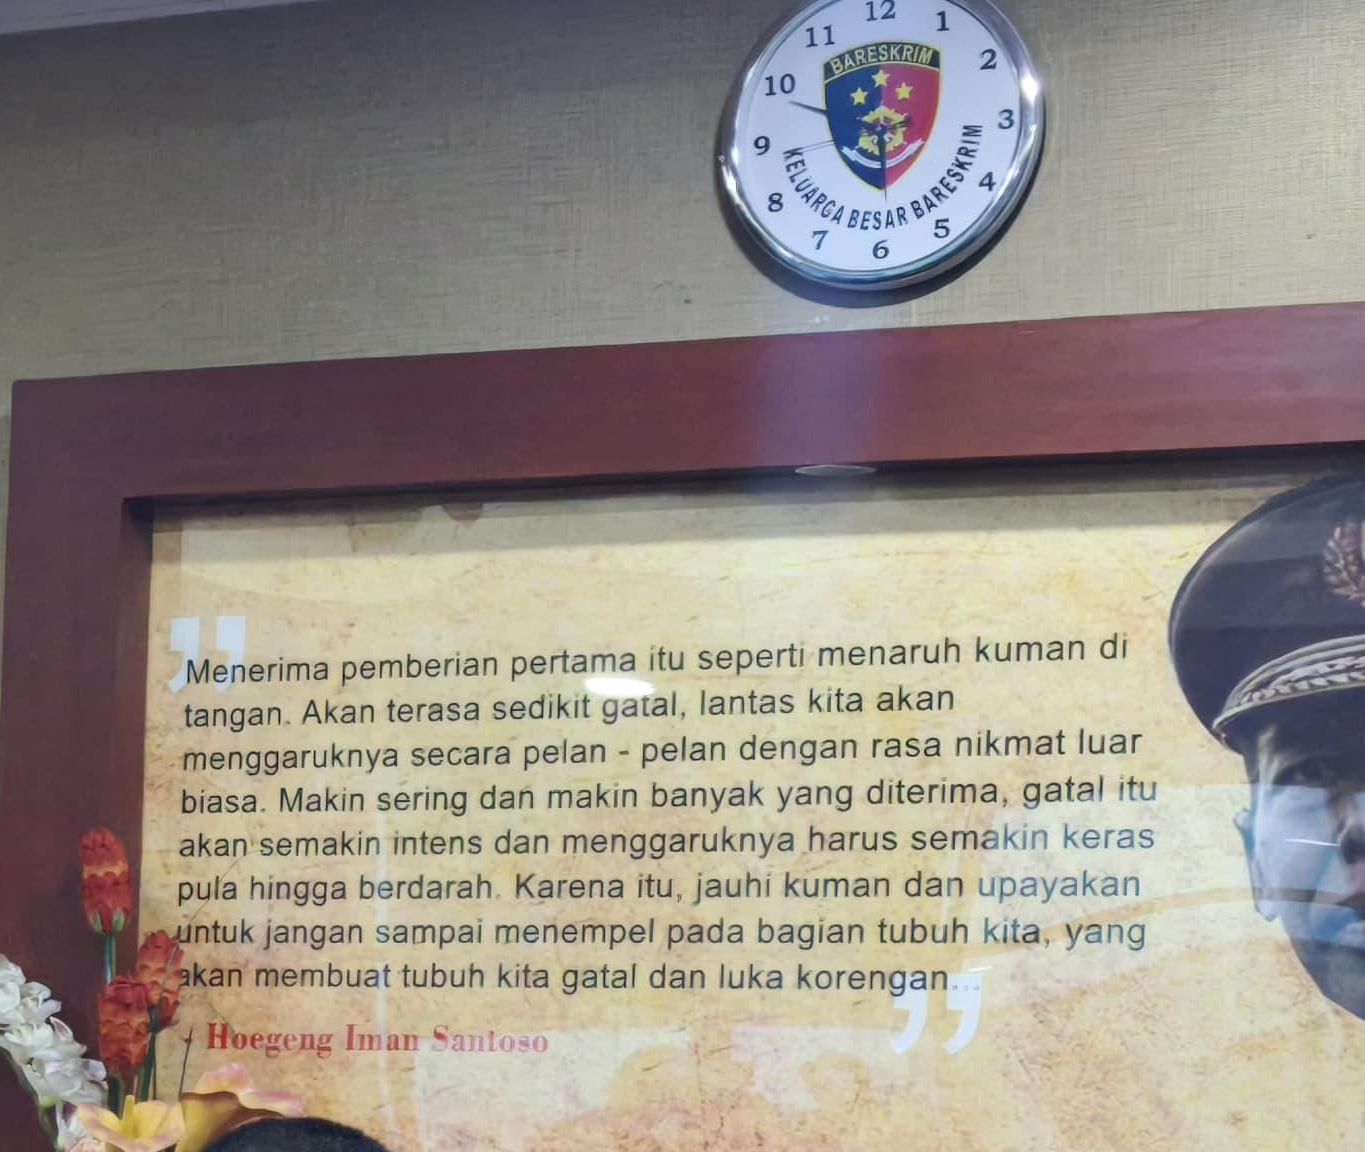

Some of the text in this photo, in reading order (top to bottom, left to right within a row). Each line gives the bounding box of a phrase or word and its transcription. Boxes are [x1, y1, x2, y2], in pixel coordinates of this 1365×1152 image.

[865, 0, 895, 22] 12
[937, 11, 949, 31] 1
[805, 25, 836, 47] 11
[830, 44, 933, 75] BARESKRIM
[980, 49, 997, 70] 2
[765, 74, 795, 96] 10
[997, 110, 1015, 129] 3
[754, 136, 770, 155] 9
[783, 125, 982, 231] KELUARGA BESAR BARESKRIM
[979, 172, 996, 191] 4
[768, 193, 783, 212] 8
[934, 218, 950, 238] 5
[812, 231, 828, 250] 7
[872, 240, 890, 259] 6
[186, 633, 1128, 685] Menerima pemberian pertama itu seperti menaruh kuman di
[185, 686, 954, 732] tangan. Akan terasa sedikit gatal, lantas kita akan
[183, 744, 398, 776] menggaruknya
[411, 746, 510, 767] secara
[524, 741, 606, 770] pelan
[642, 736, 725, 767] pelan
[740, 735, 857, 766] dengan
[871, 737, 941, 758] rasa
[955, 730, 1066, 757] nikmat
[1080, 729, 1142, 754] luar
[182, 776, 1157, 815] biasa. Makin sering dan makin banyak yang diterima, gatal itu
[180, 823, 1154, 859] akan semakin intens dan menggaruknya harus semakin keras
[178, 871, 1141, 906] pula hingga berdarah. Karena itu, jauhi kuman dan upayakan
[176, 917, 1145, 951] untuk jangan sampai menempel pada bagian tubuh kita, yang
[180, 963, 242, 987] akan
[255, 964, 390, 988] membuat
[403, 963, 484, 988] tubuh
[498, 963, 549, 988] kita
[563, 962, 635, 994] gatal
[650, 964, 705, 989] dan
[720, 965, 782, 988] luka
[207, 1023, 549, 1058] Hoegeng Iman Santoso
